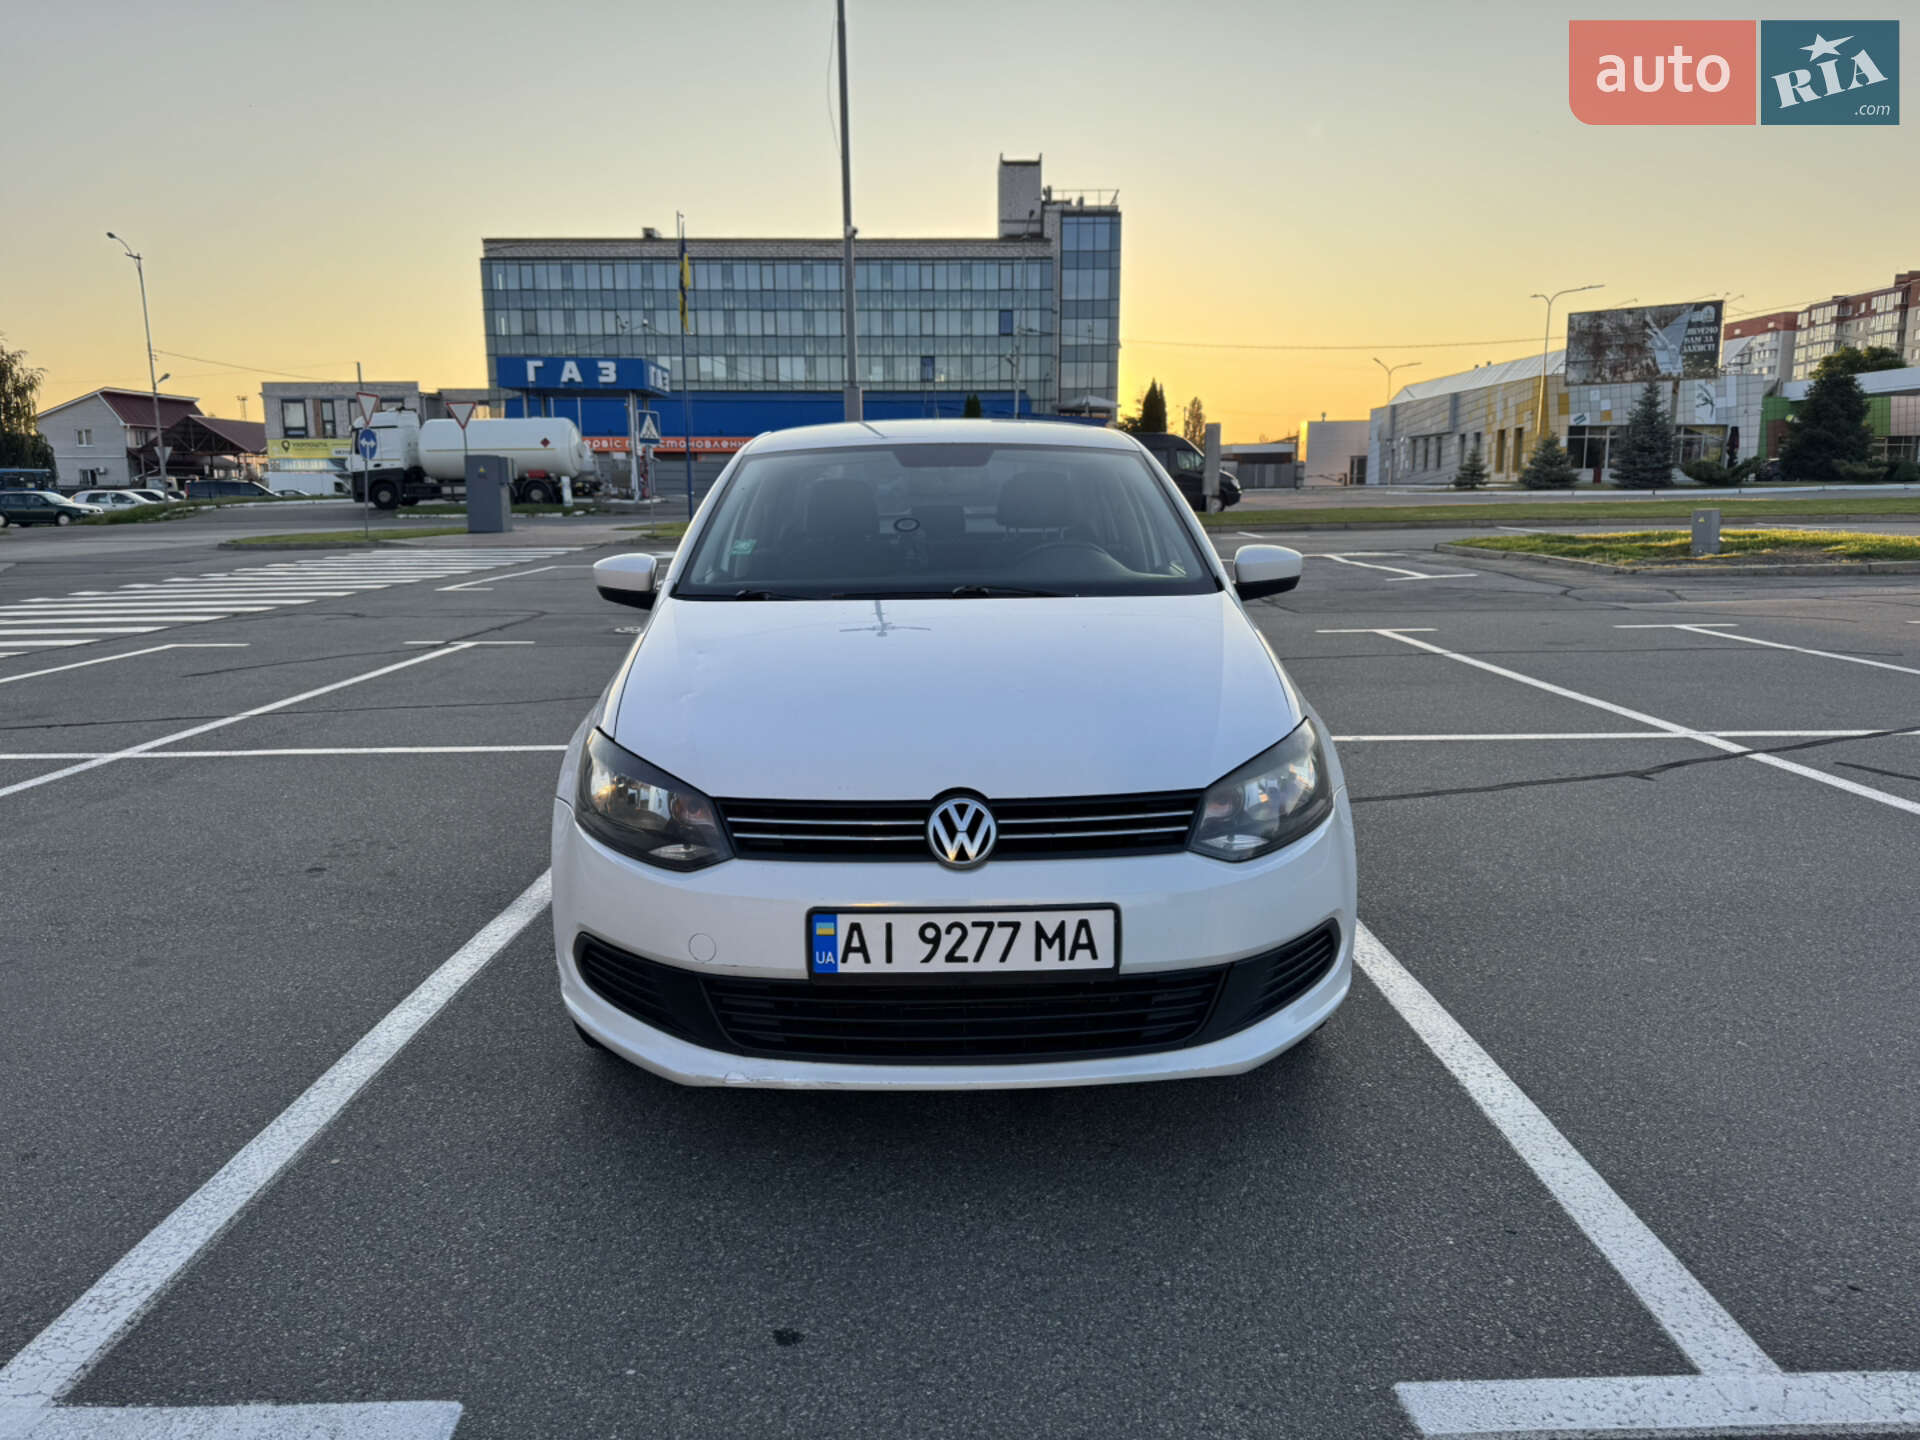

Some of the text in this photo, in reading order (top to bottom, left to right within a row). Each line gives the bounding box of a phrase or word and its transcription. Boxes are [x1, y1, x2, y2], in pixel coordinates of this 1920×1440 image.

[526, 360, 617, 383] ГАЗ
[583, 439, 623, 449] ервіс
[816, 919, 1099, 964] UA AI 9277 MA
